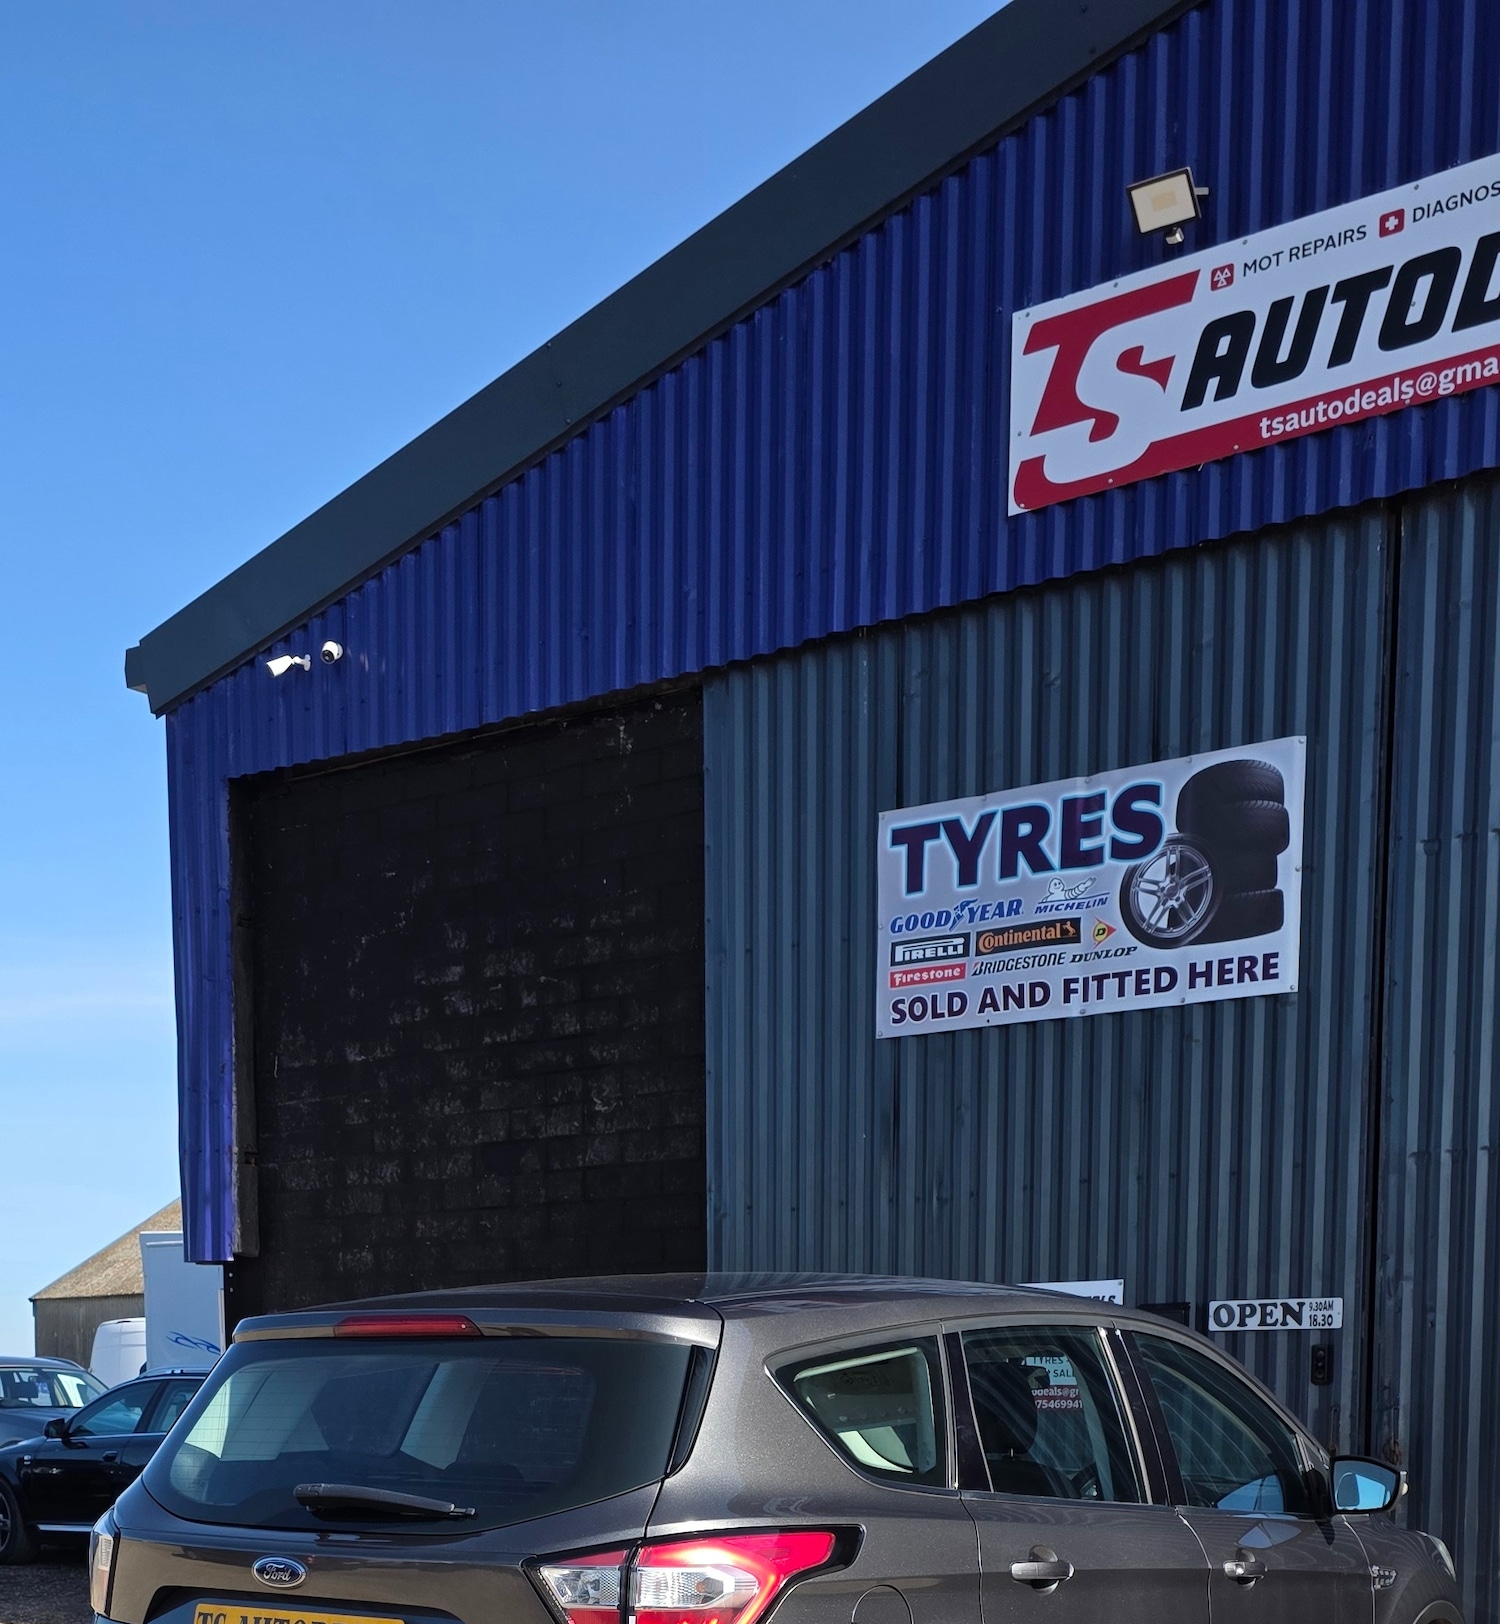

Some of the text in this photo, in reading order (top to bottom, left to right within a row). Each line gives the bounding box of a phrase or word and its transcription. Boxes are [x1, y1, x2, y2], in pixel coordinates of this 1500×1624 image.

[1243, 225, 1367, 277] MOT REPAIRS
[891, 783, 1164, 895] TYRES
[1035, 896, 1109, 914] MICHELIN
[895, 938, 965, 963] PIRELLI
[979, 923, 1063, 953] Continental
[972, 952, 1067, 977] BRIDGESTONE
[1069, 946, 1138, 963] DUNLOP
[894, 967, 962, 984] Firestone
[891, 952, 1280, 1025] SOLD AND FITTED HERE
[1213, 1301, 1305, 1328] OPEN
[1309, 1314, 1333, 1328] 18.30
[263, 1563, 291, 1581] Ford
